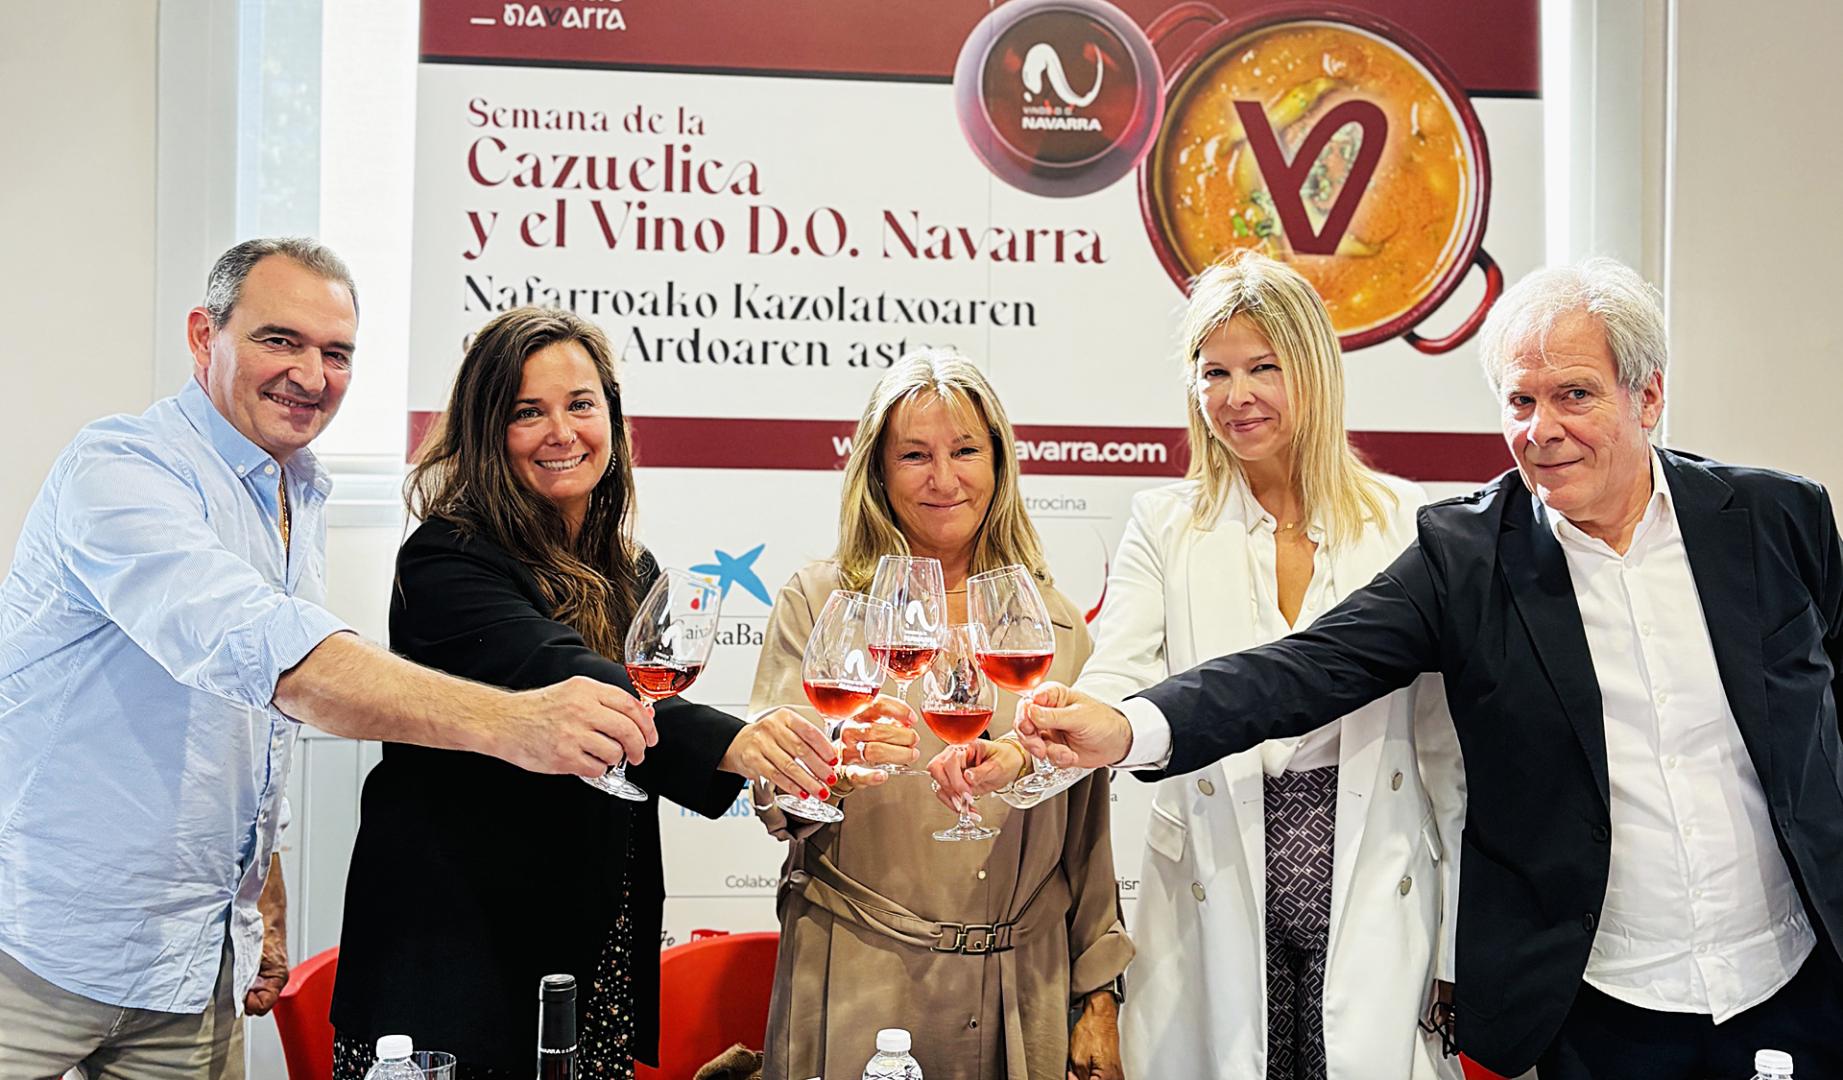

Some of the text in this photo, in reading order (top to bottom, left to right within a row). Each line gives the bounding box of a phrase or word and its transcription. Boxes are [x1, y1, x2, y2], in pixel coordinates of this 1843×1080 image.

[467, 97, 706, 135] Semana de la
[1021, 117, 1102, 131] NAVARRA
[467, 136, 765, 196] Cazuelica
[462, 198, 1110, 264] y el Vino D.O. Navarra
[464, 275, 1038, 328] Nafarroako Kazolatxoaren
[620, 326, 831, 368] Ardoaren
[1015, 440, 1167, 463] avarra.com
[1024, 494, 1087, 511] trocina
[725, 874, 779, 889] Colabo
